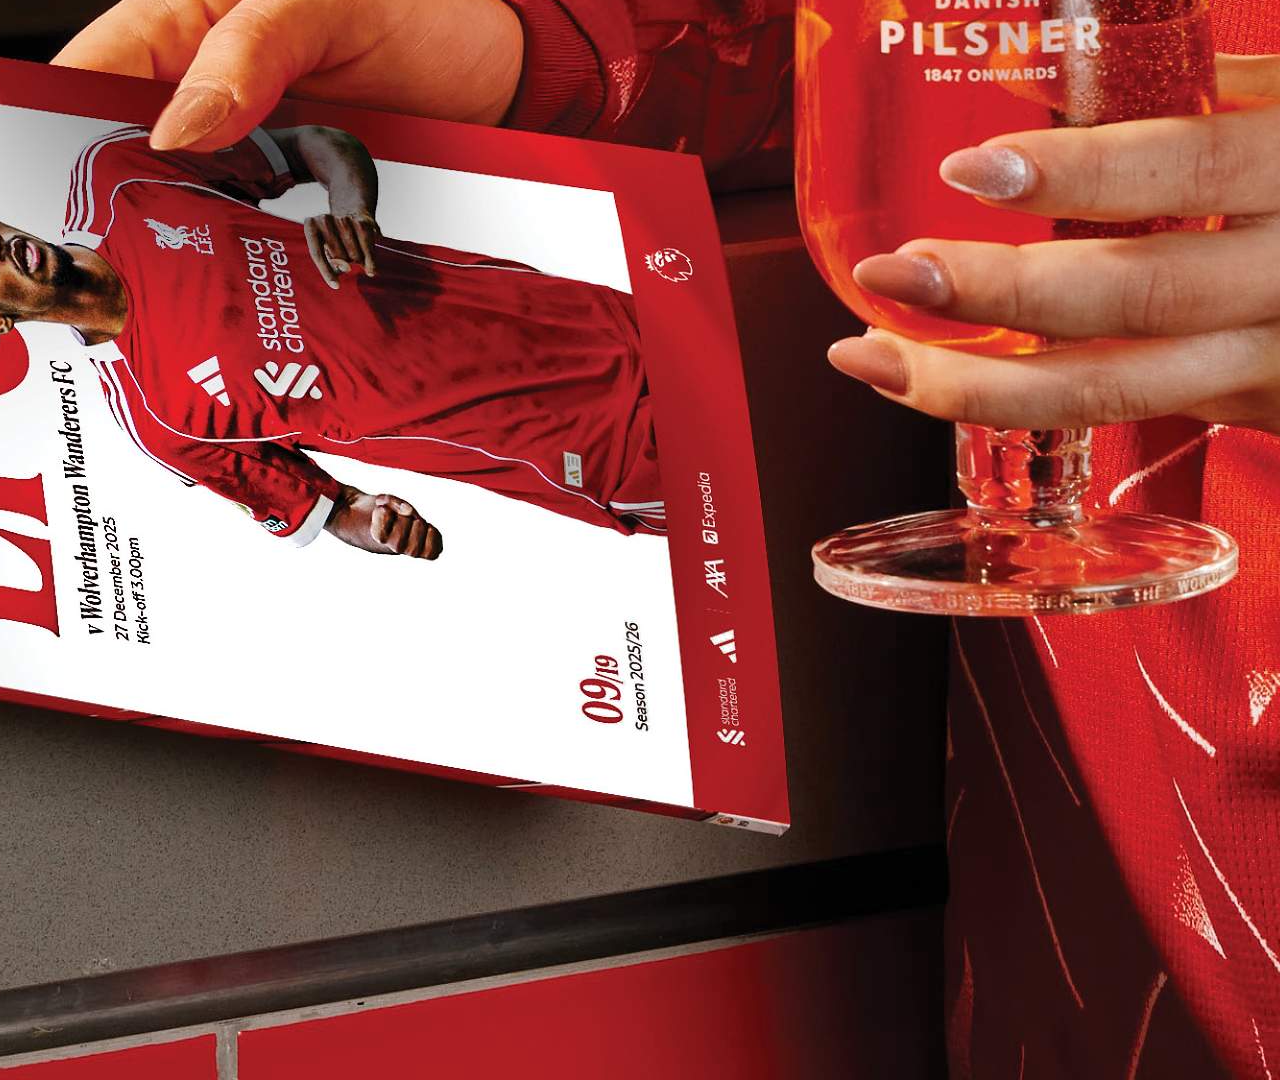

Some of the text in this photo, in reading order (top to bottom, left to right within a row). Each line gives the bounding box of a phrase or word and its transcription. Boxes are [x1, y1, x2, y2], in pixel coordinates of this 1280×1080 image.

[880, 17, 1102, 56] PILSNER
[923, 65, 1058, 83] 1847 ONWARDS
[239, 236, 282, 352] standard
[262, 237, 306, 354] chartered
[49, 360, 105, 635] v Wolverhampton Wanderers FC
[697, 472, 718, 529] Expedia
[102, 516, 130, 642] 27 December 2025
[128, 537, 151, 645] Kick-off 3.00pm
[703, 558, 729, 599] AXA
[1132, 585, 1164, 602] THE
[579, 654, 624, 724] 09/19
[624, 621, 649, 732] Season 2025/26
[717, 678, 731, 726] standard
[726, 677, 740, 727] chartered
